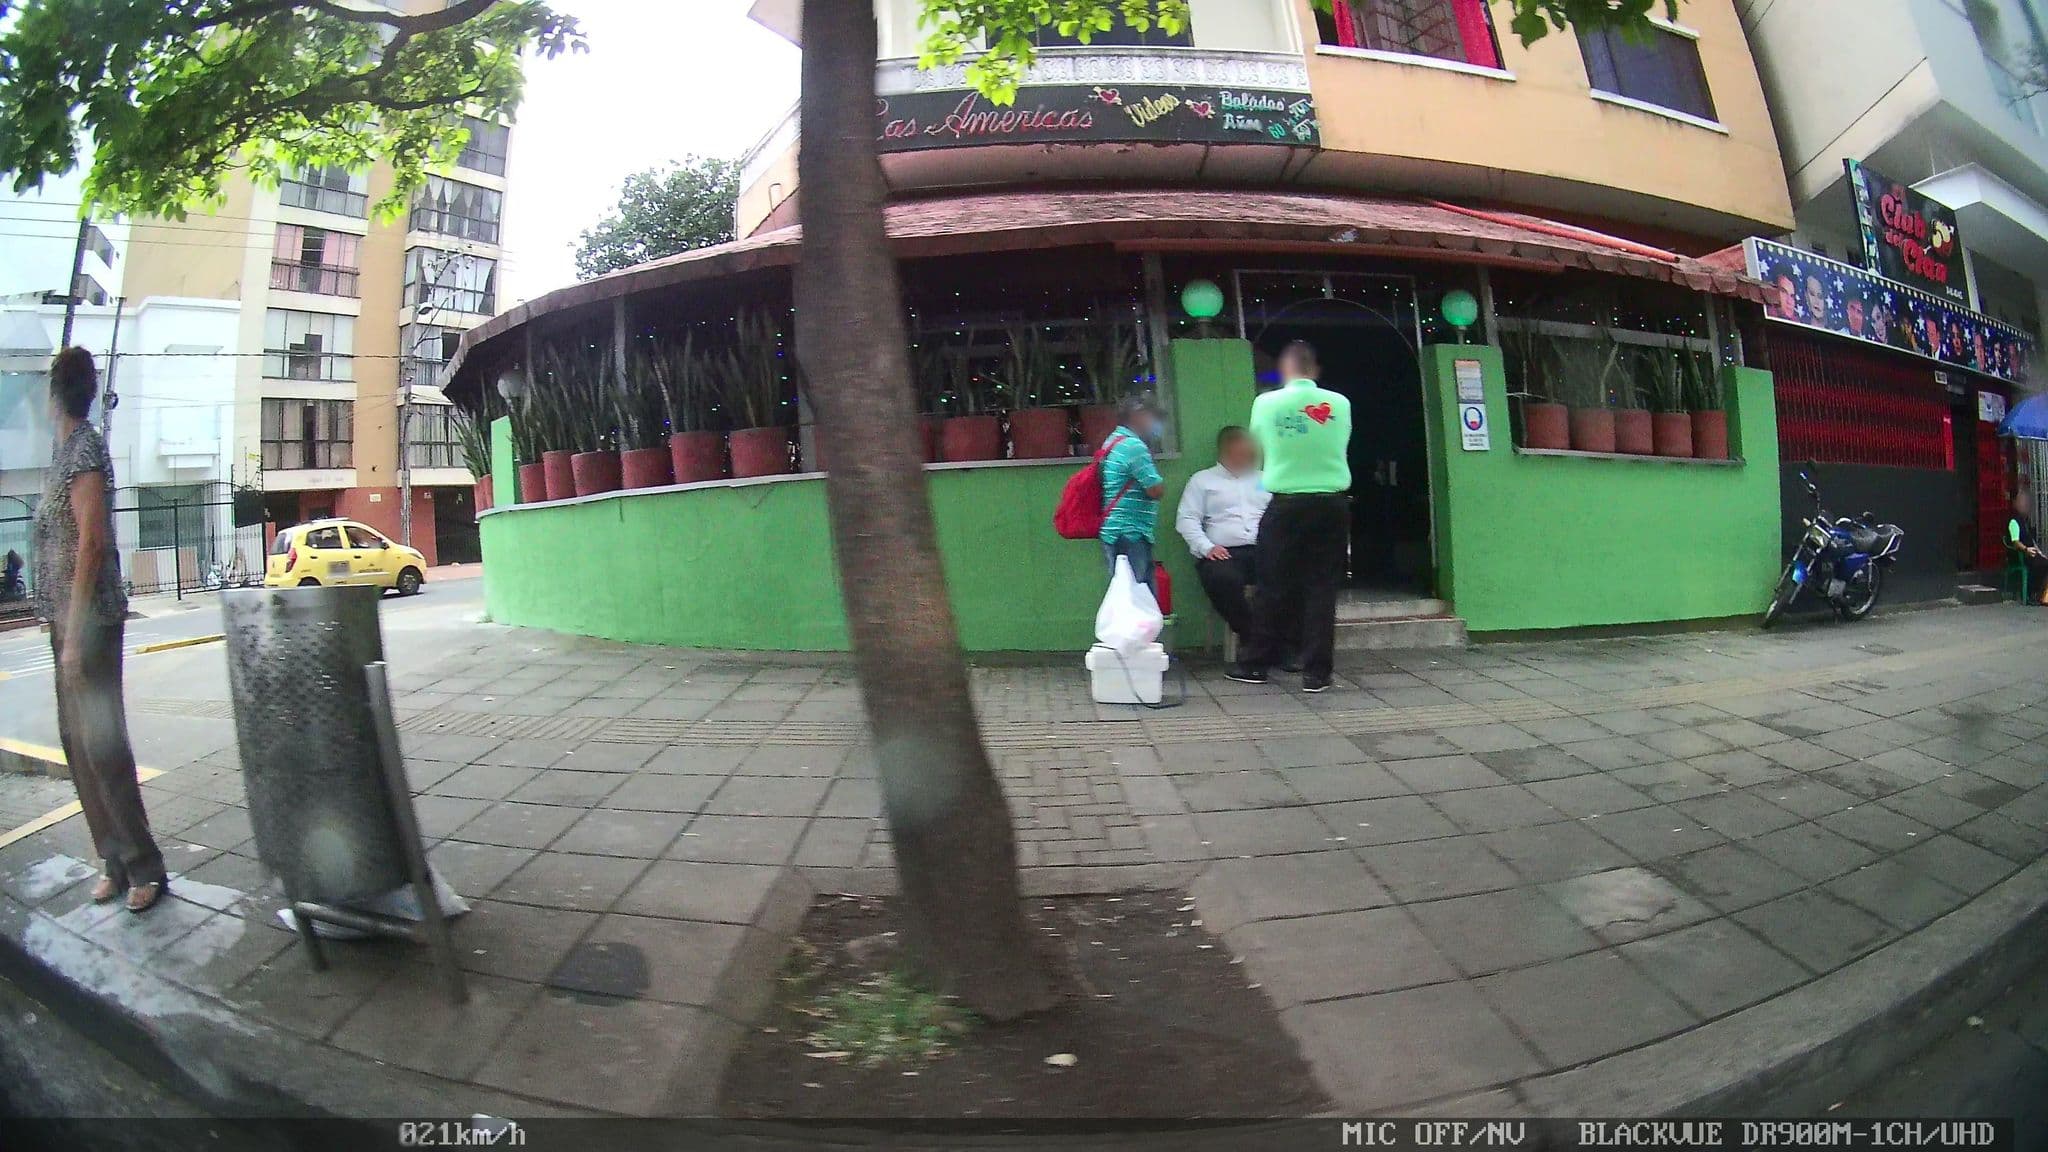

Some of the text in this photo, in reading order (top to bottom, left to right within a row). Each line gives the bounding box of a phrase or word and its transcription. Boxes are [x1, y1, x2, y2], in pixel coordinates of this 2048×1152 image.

[924, 91, 1093, 139] Americas
[1123, 92, 1180, 128] Videos
[1219, 90, 1286, 112] Baladas
[1881, 193, 1927, 240] Club
[1903, 238, 1948, 284] Clan
